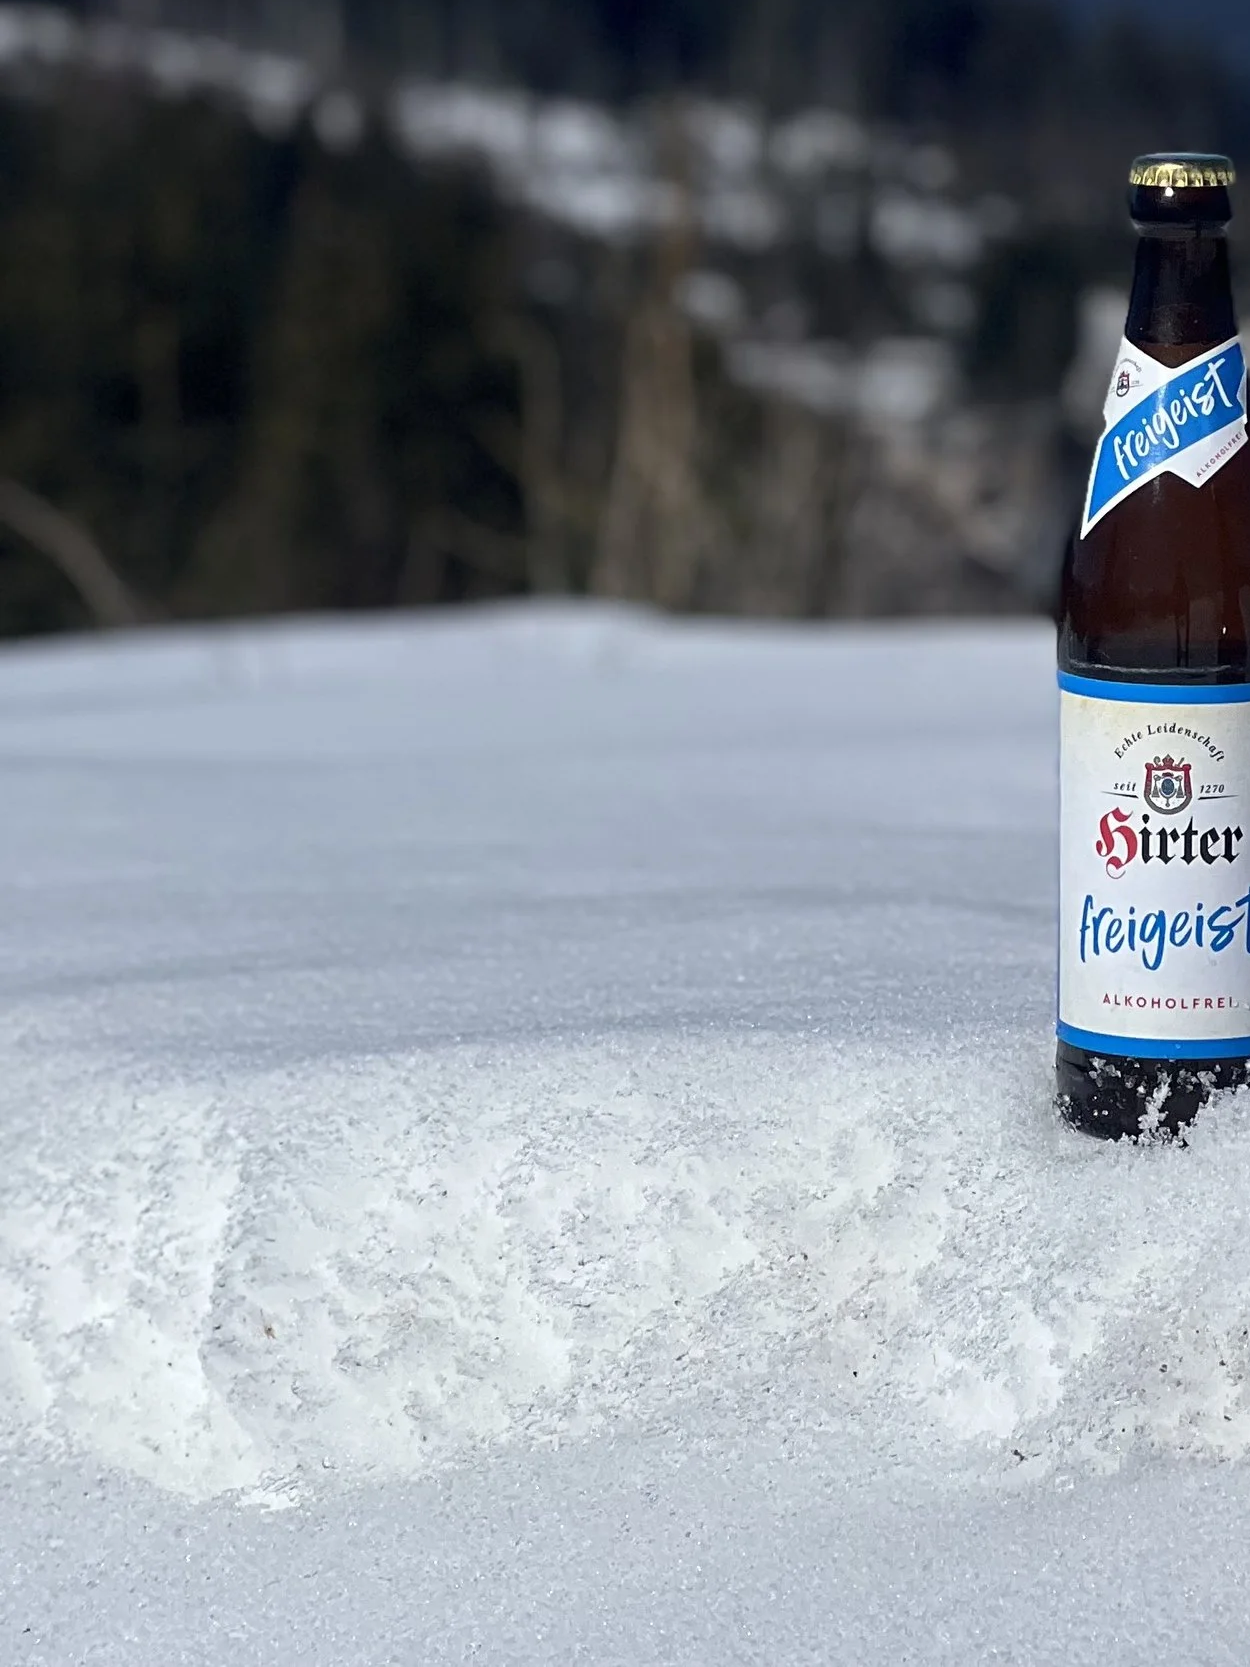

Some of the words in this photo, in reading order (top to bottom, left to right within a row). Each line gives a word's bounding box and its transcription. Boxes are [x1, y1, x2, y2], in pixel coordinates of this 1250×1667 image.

[1113, 357, 1233, 481] freigeist
[1114, 730, 1144, 759] Echte
[1146, 722, 1225, 763] Leidenschaft
[1113, 781, 1137, 792] seit
[1199, 784, 1225, 794] 1270
[1095, 806, 1244, 880] Hirter
[1102, 993, 1233, 1010] ALKOHOLFREI
